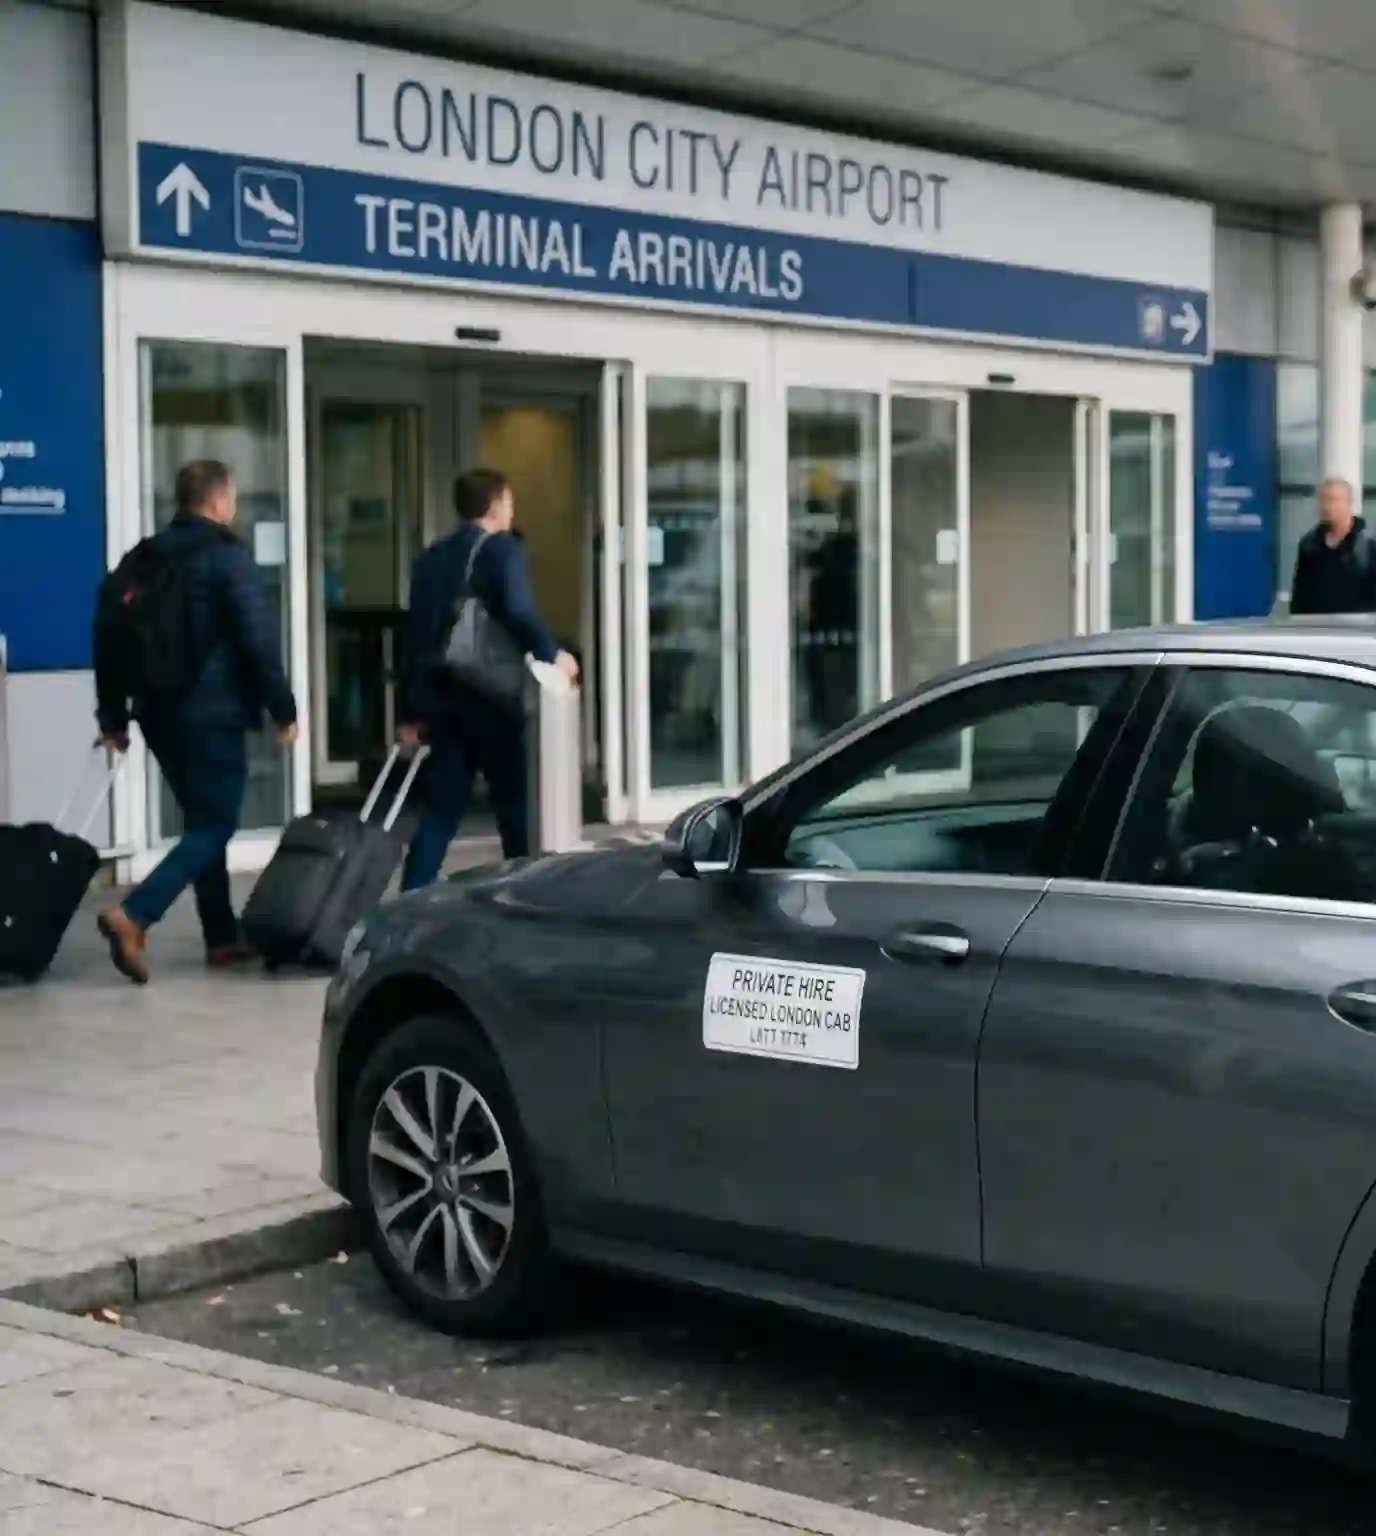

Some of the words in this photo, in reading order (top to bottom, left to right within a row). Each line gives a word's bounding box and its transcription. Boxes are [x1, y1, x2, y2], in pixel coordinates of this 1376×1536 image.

[355, 71, 605, 182] LONDON
[627, 120, 741, 201] CITY
[756, 145, 950, 233] AIRPORT
[354, 193, 597, 278] TERMINAL
[608, 228, 804, 301] ARRIVALS
[709, 995, 768, 1020] LICENSED
[770, 1005, 822, 1029] LONDON
[824, 1011, 852, 1032] CAB
[732, 969, 795, 997] PRIVATE
[798, 975, 835, 1002] HIRE
